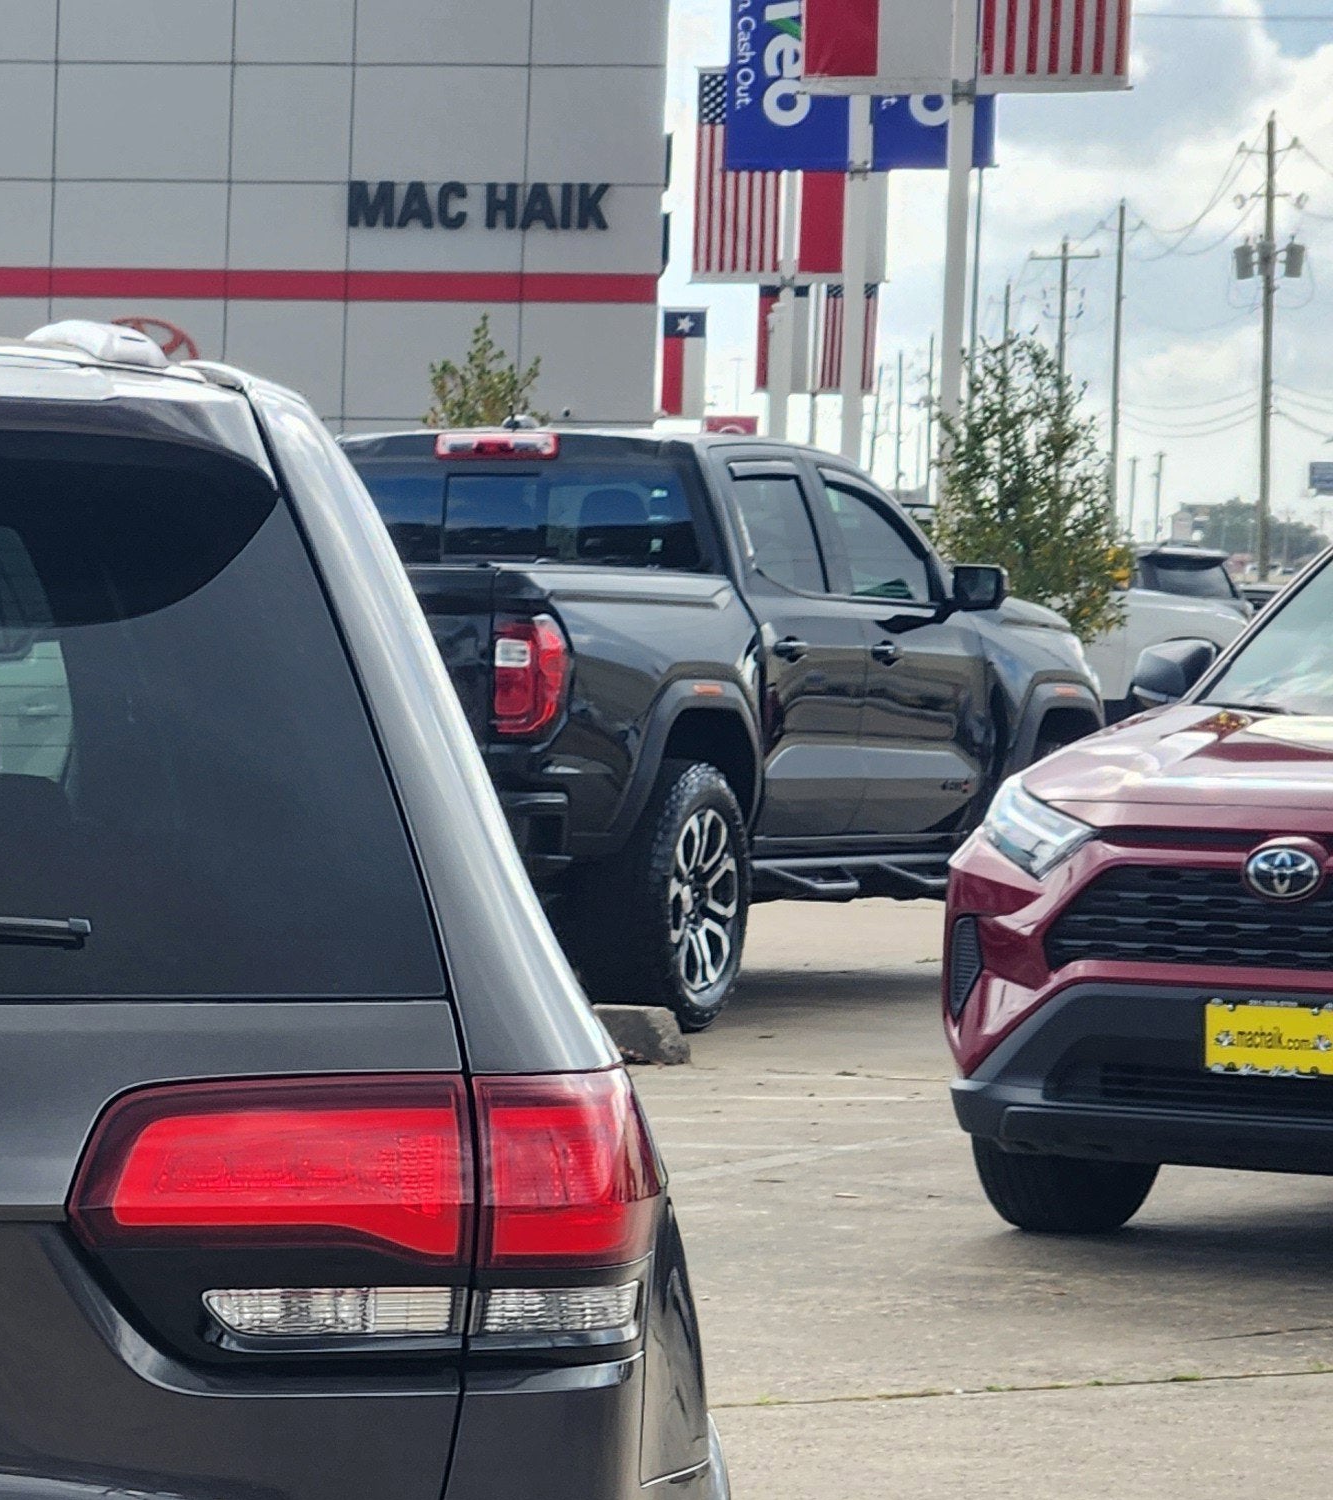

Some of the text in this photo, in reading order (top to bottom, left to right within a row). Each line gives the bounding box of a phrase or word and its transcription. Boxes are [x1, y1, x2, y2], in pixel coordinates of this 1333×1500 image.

[737, 16, 757, 64] Cash
[735, 67, 756, 110] Out.
[348, 180, 611, 231] MAC HAIK
